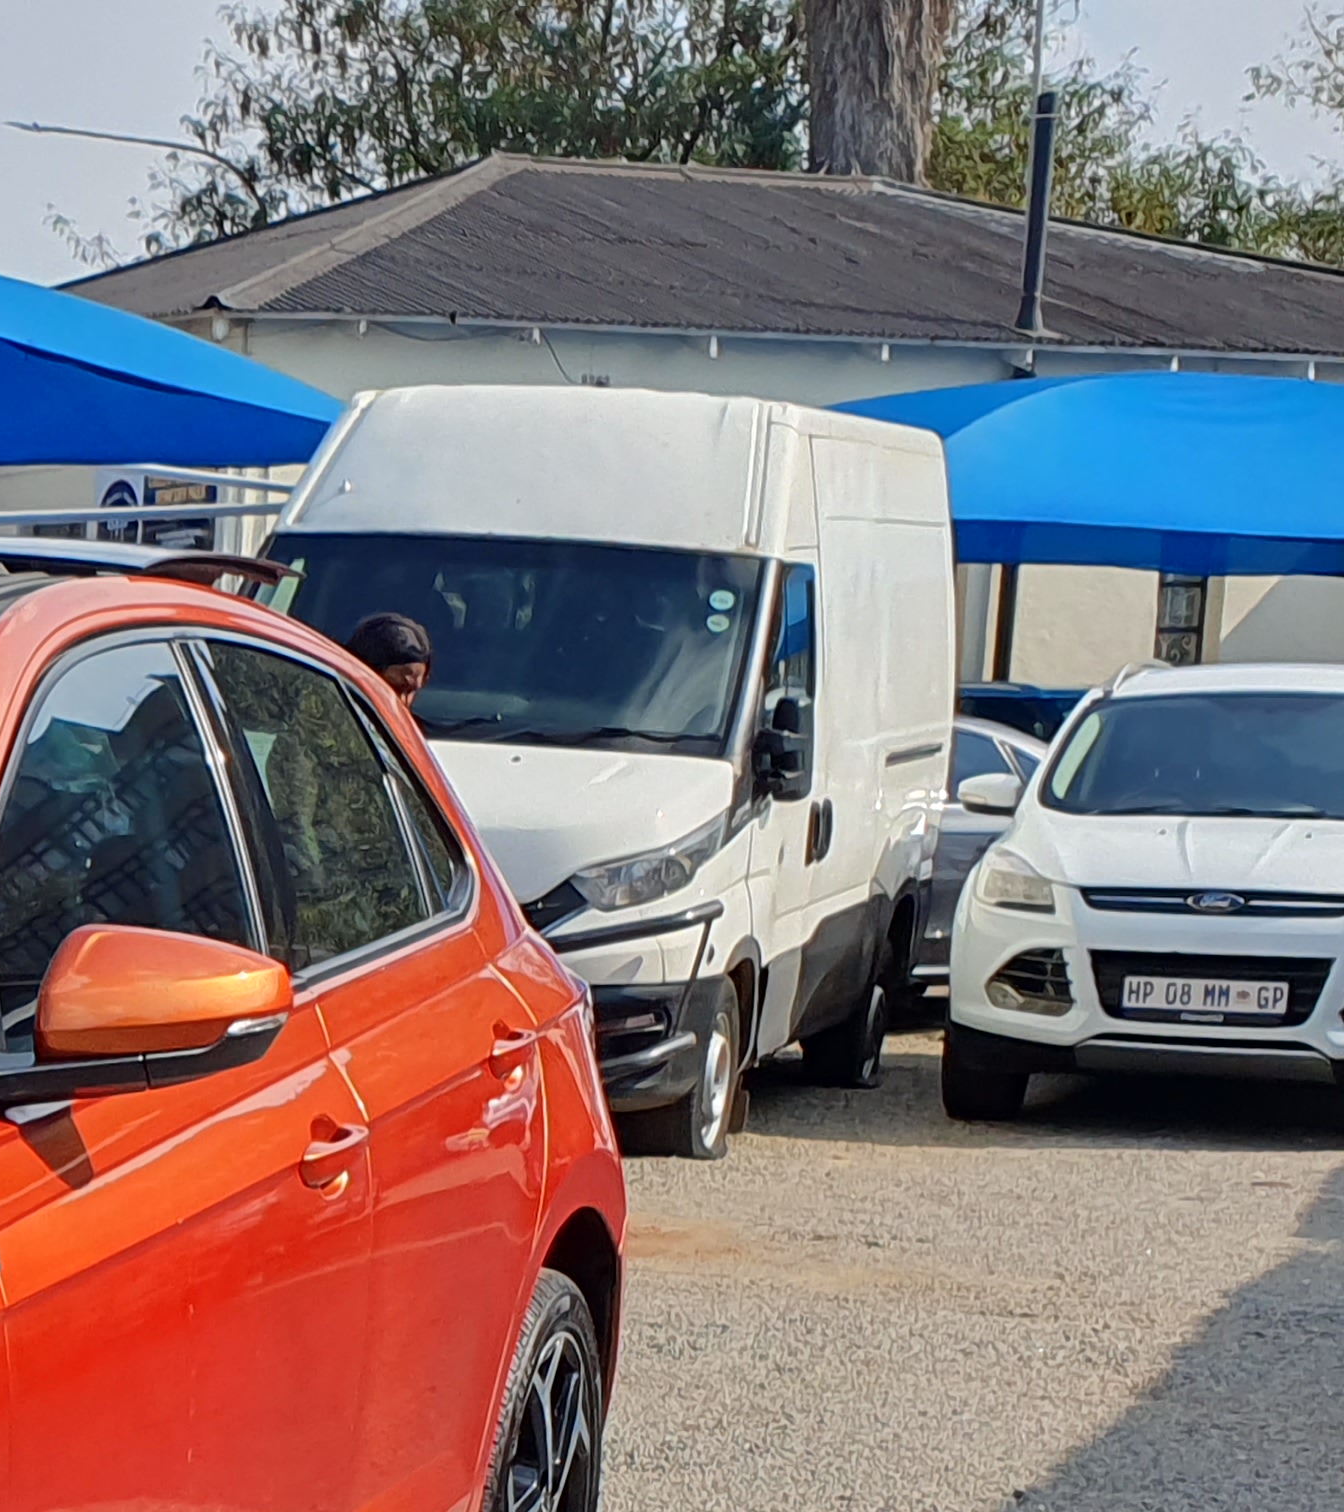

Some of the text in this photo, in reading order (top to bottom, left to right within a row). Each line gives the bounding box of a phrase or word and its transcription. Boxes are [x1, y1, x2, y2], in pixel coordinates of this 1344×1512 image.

[1128, 981, 1284, 1010] HP 08 MM GP
